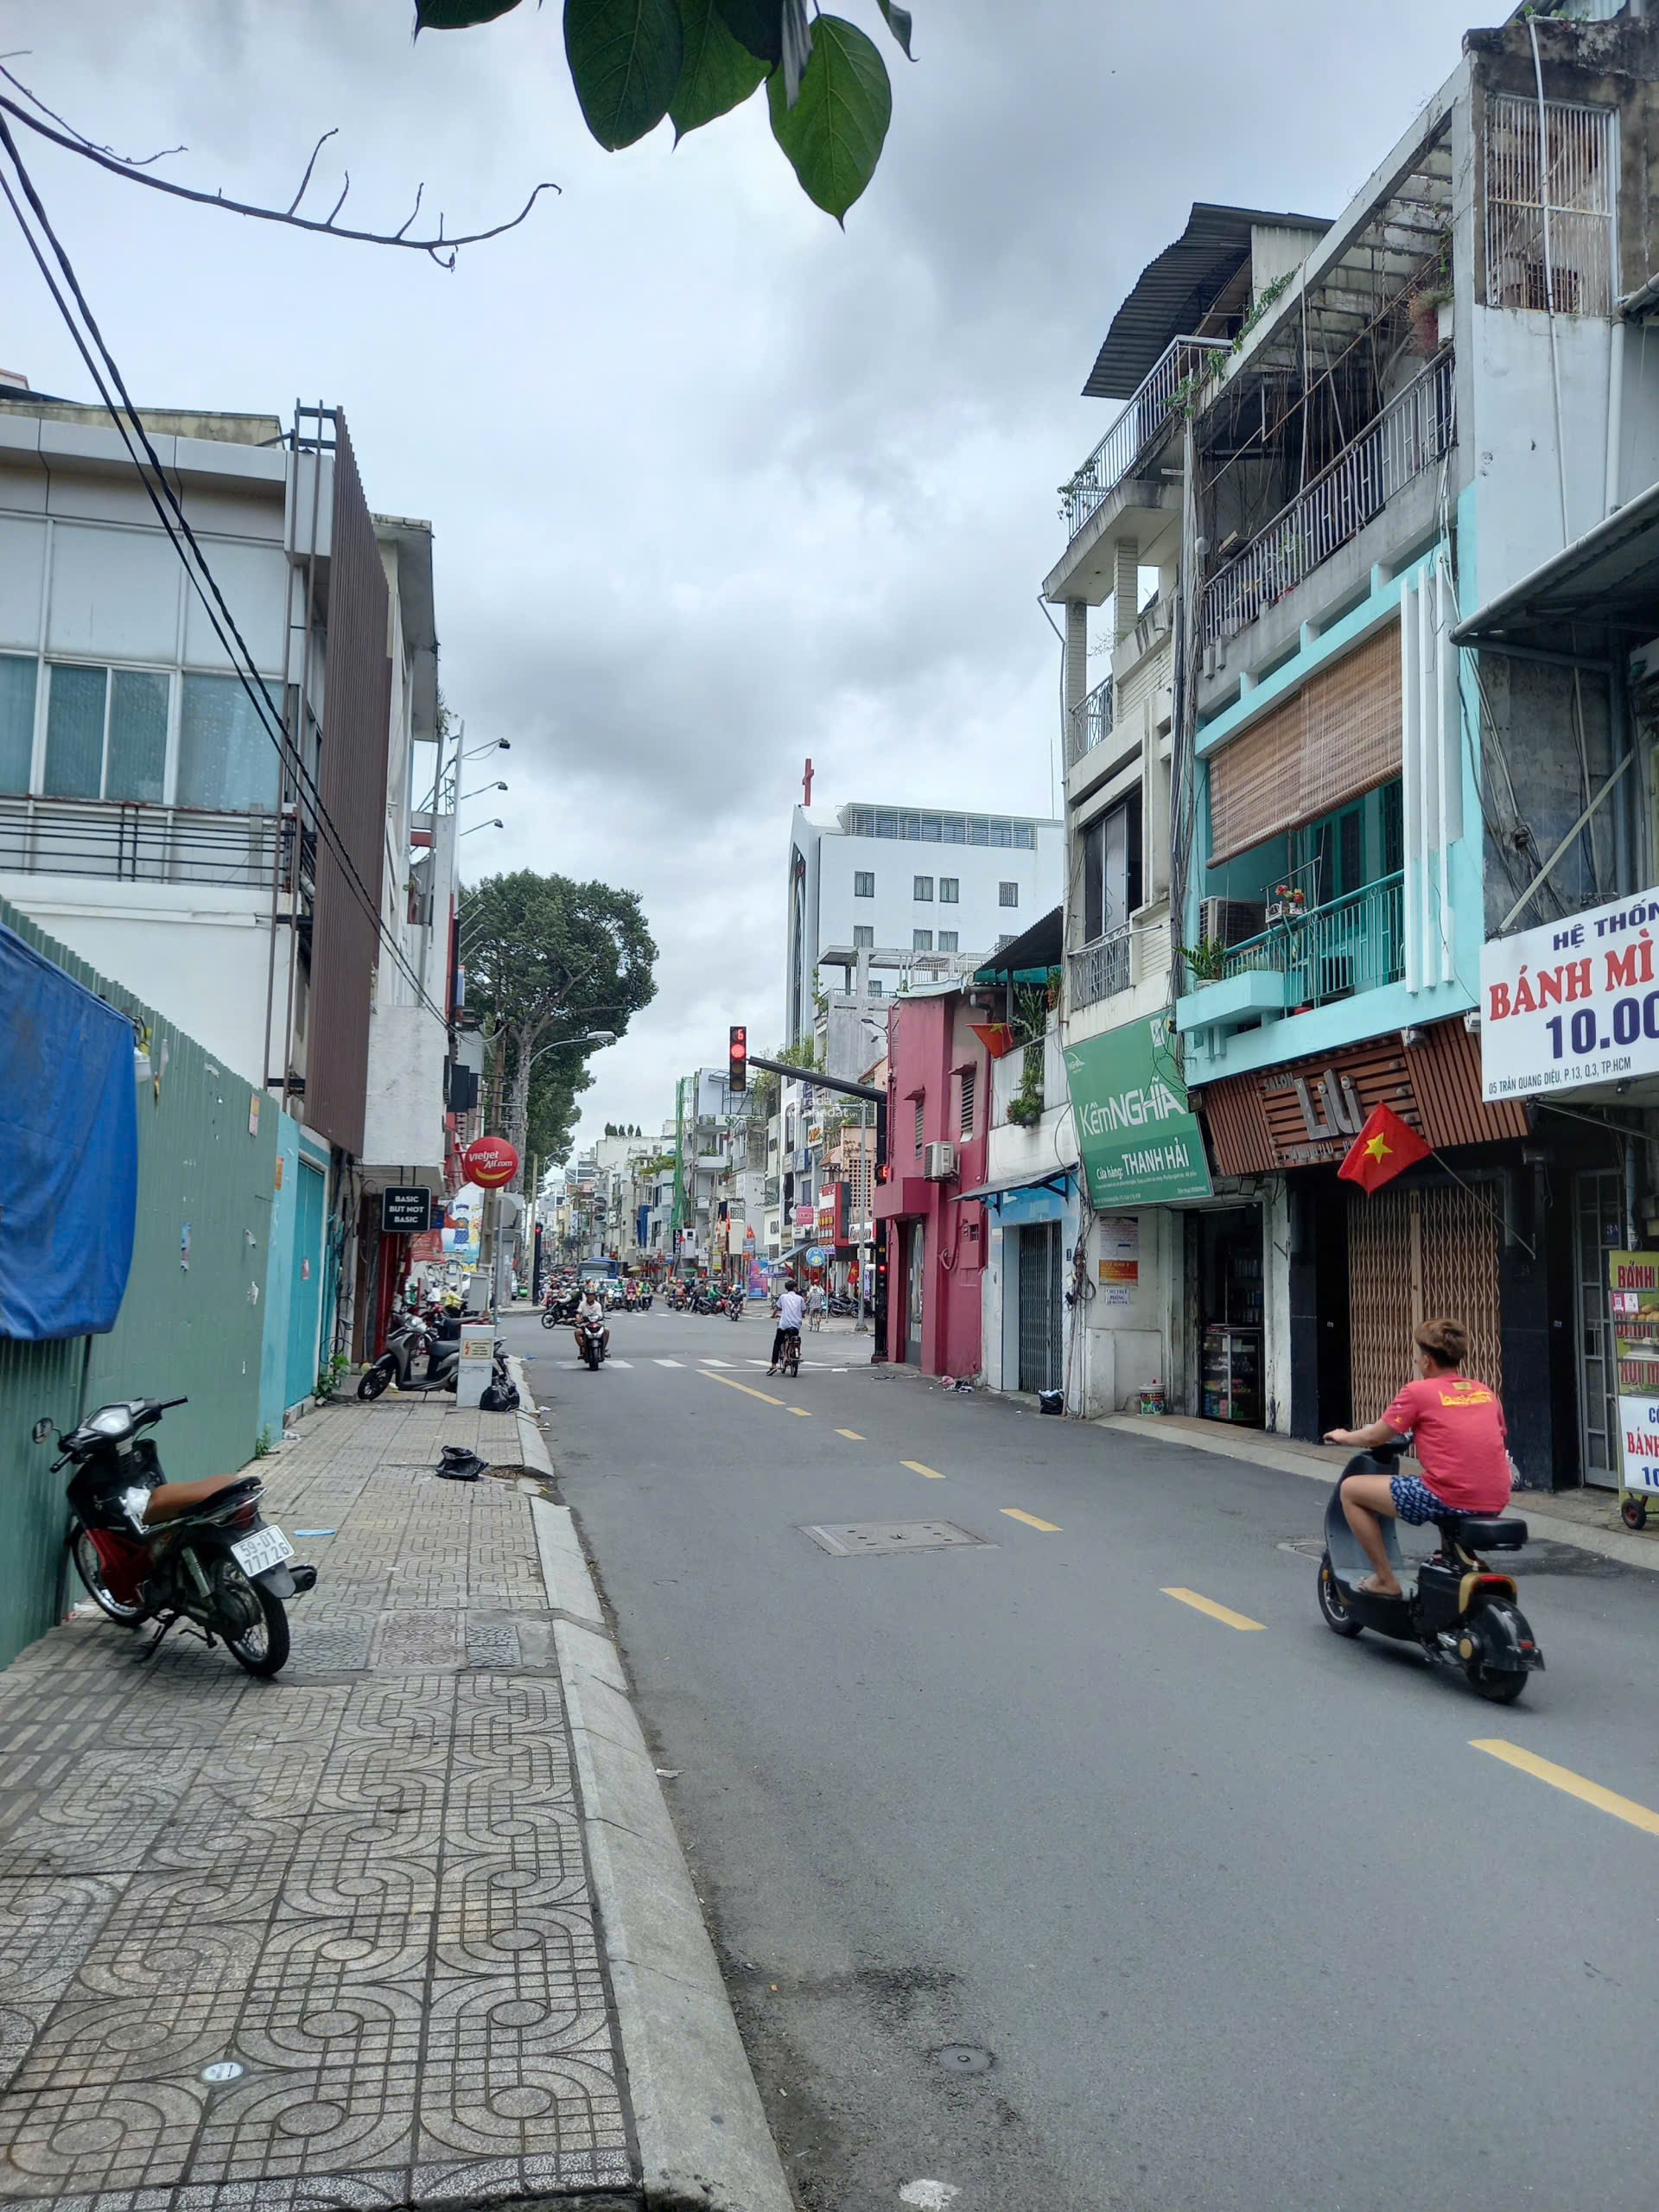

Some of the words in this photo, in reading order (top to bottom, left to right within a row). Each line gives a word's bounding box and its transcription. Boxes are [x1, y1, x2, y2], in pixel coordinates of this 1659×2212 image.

[1554, 924, 1585, 950] HỆ
[1489, 957, 1592, 1021] BÁNH
[1605, 928, 1655, 992] MÌ
[1489, 1082, 1497, 1095] 05
[1518, 1074, 1542, 1090] QUANG
[1601, 1056, 1631, 1074] TP.HCM
[1122, 1147, 1165, 1176] THANH
[1166, 1136, 1189, 1170] HẢI
[1618, 1259, 1653, 1288] BÁNH
